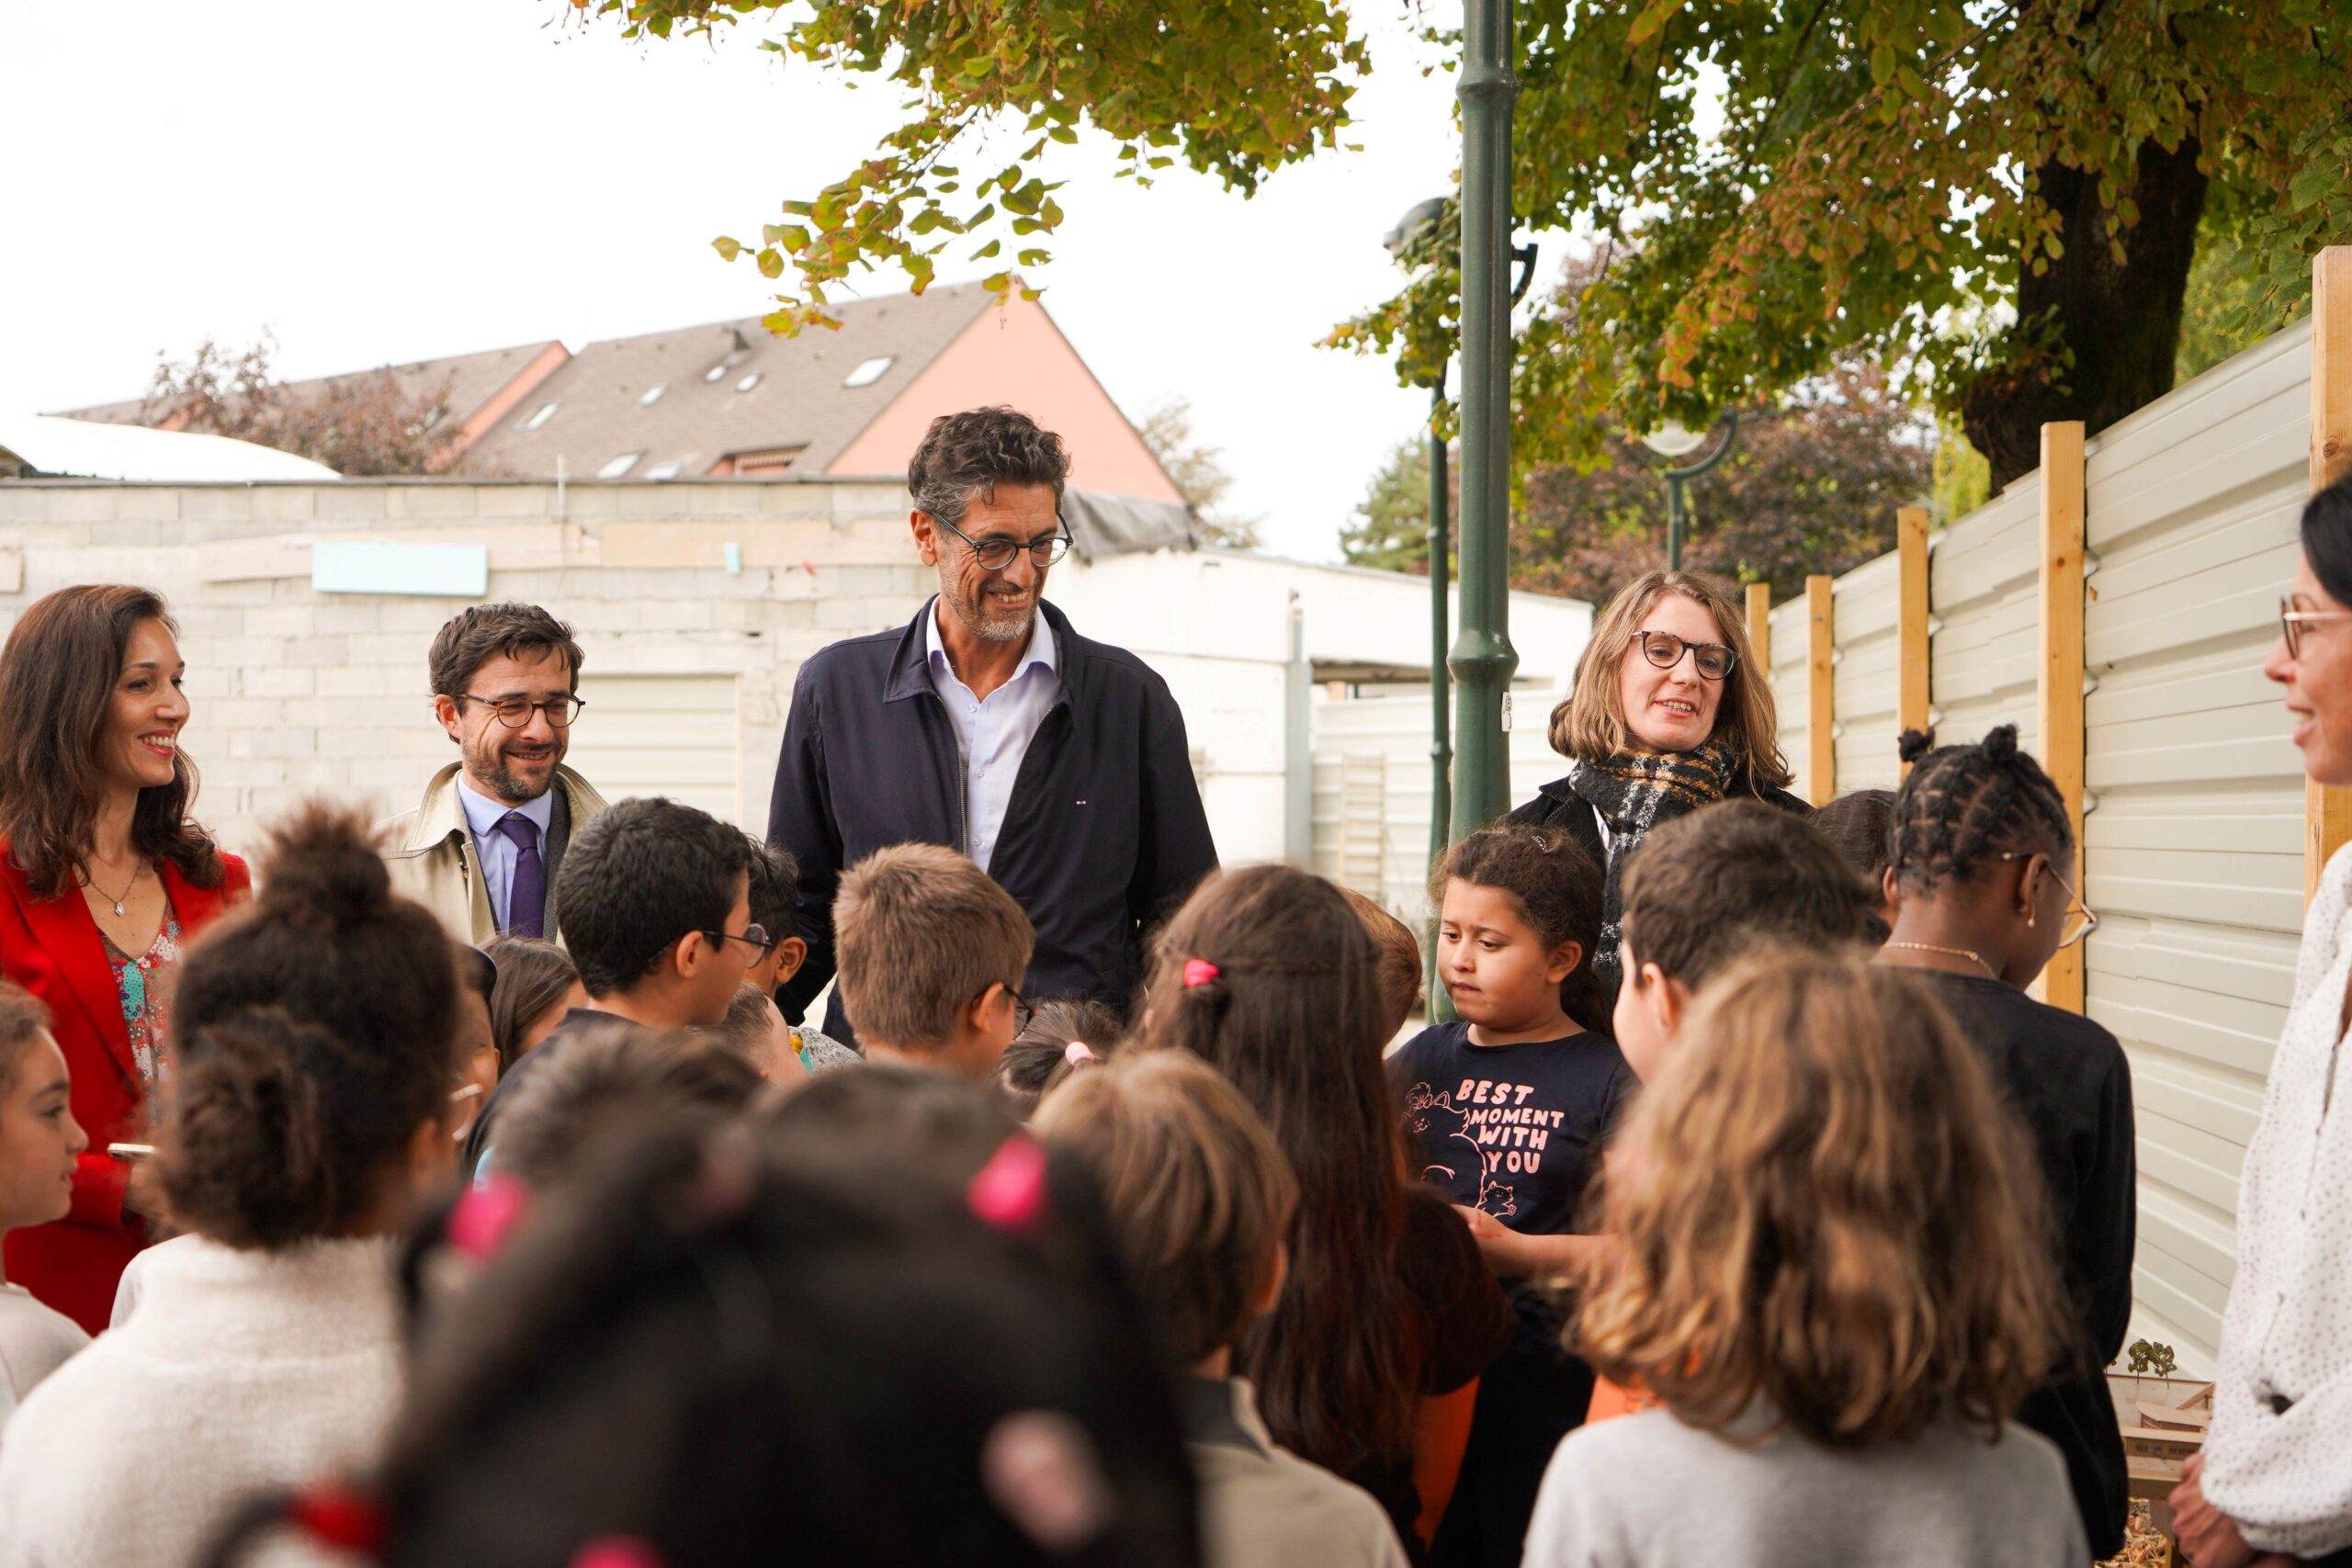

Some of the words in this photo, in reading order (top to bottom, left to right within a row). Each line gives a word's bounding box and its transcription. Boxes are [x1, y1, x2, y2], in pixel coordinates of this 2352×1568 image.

[1455, 1079, 1534, 1105] BEST
[1470, 1108, 1565, 1128] MOMENT
[1477, 1125, 1549, 1150] WITH
[1486, 1151, 1541, 1174] YOU
